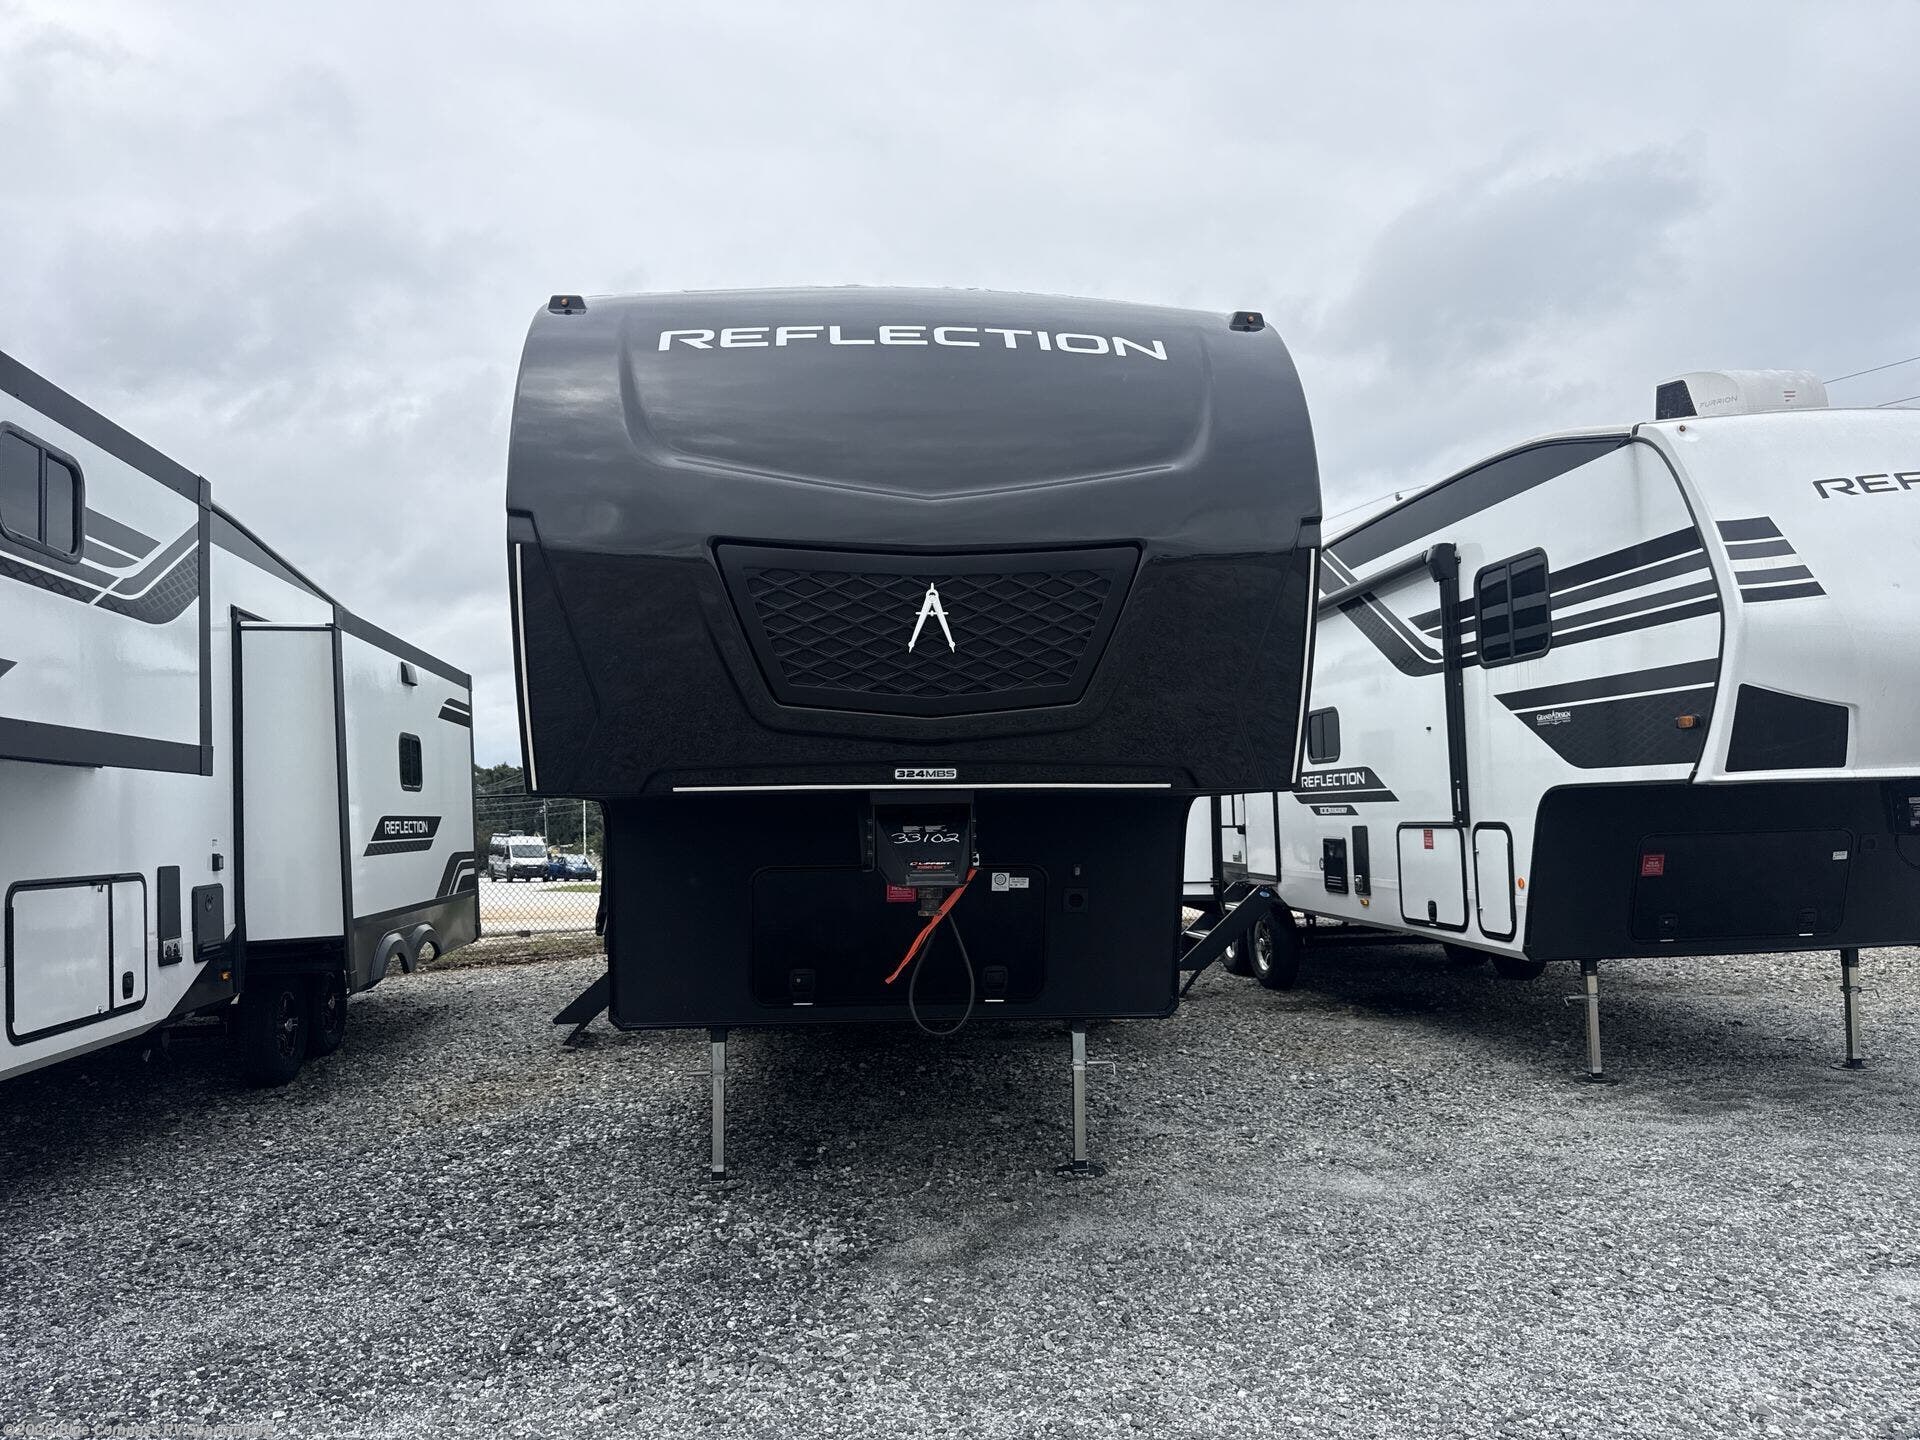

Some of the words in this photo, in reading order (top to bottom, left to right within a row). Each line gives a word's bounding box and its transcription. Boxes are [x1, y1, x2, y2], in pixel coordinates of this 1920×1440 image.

[657, 325, 1168, 361] REFLECTION
[896, 769, 956, 778] 324MBS
[1301, 771, 1365, 788] REFLECTION
[384, 820, 428, 834] REFLECTION
[891, 833, 960, 844] 33102
